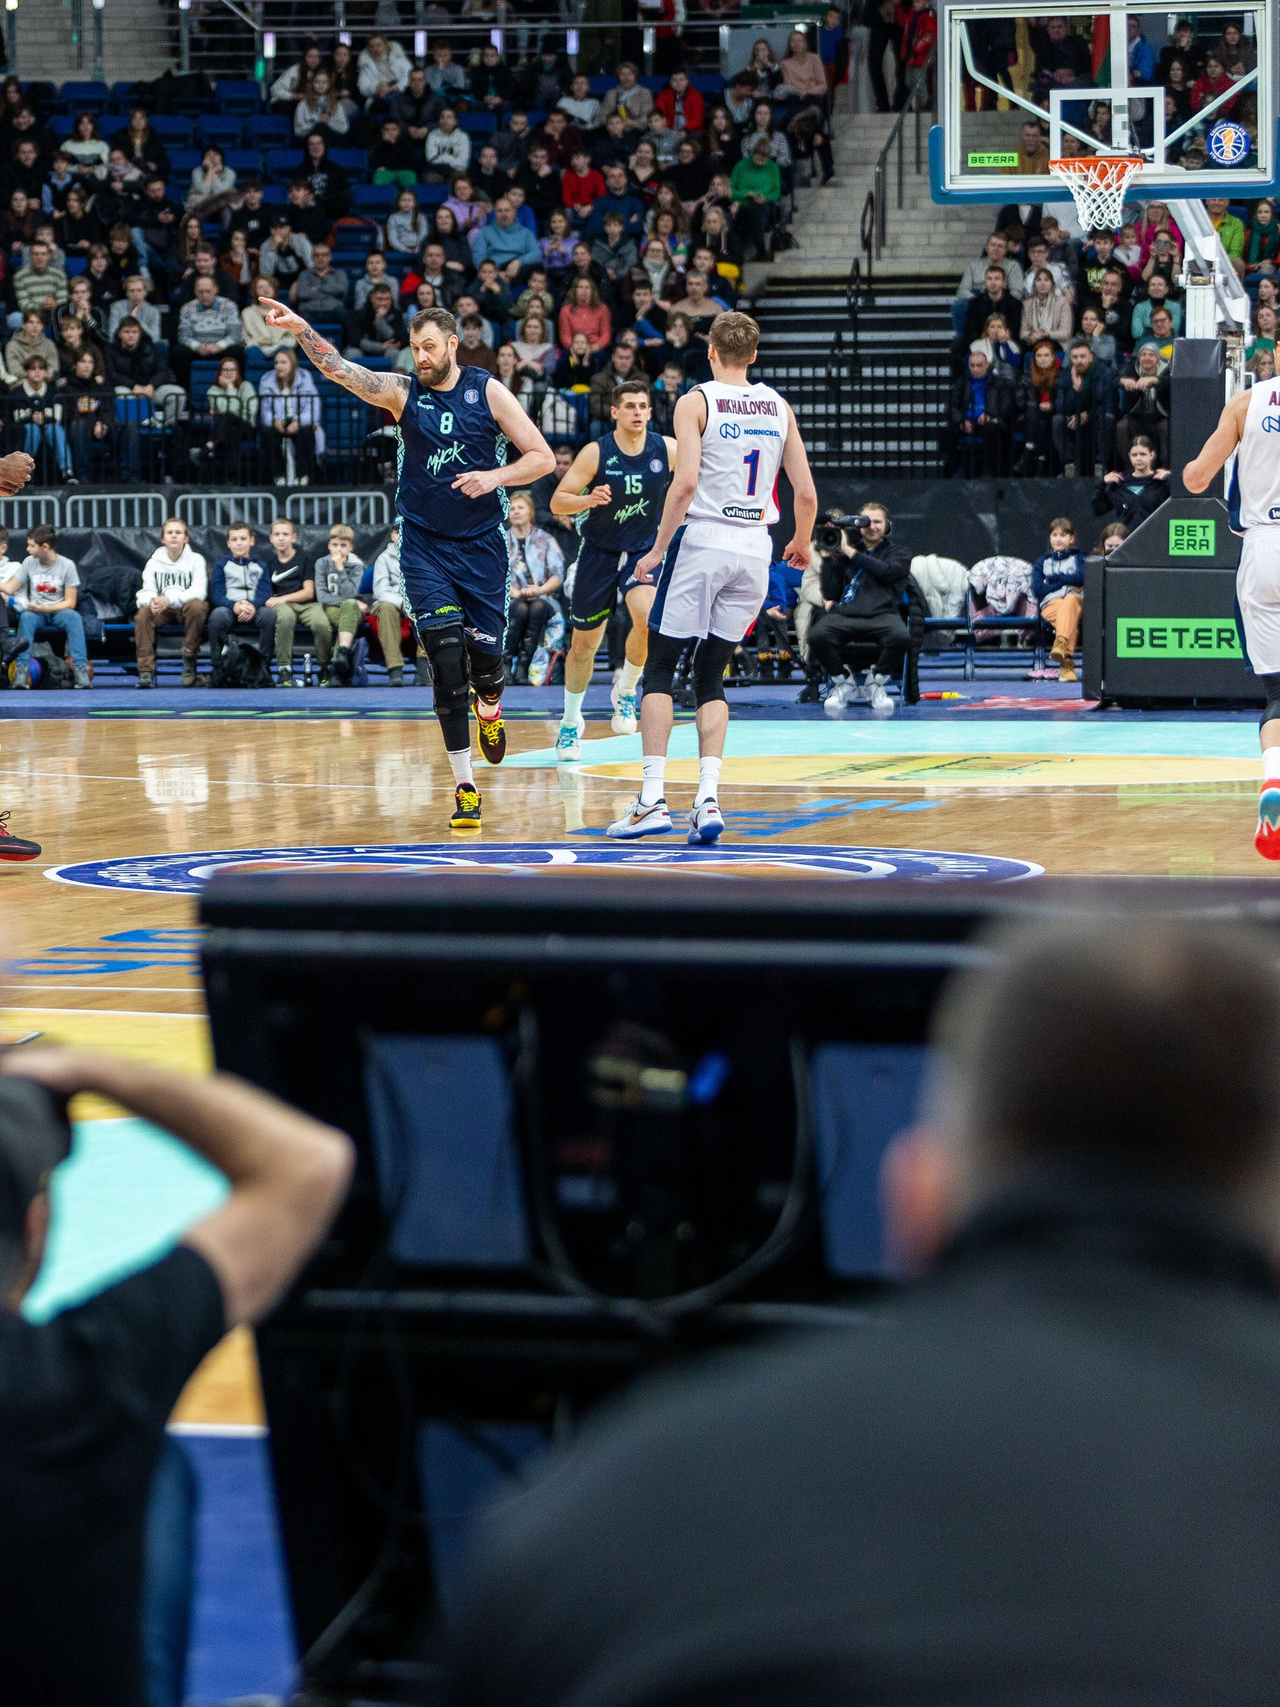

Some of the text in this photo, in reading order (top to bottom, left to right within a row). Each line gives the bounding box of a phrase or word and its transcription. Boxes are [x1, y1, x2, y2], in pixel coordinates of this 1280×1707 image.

[440, 412, 454, 435] 8
[743, 429, 781, 438] NORNICKEL
[742, 449, 761, 497] 1
[624, 474, 643, 495] 15
[725, 507, 761, 519] Winline
[1174, 525, 1210, 537] BET
